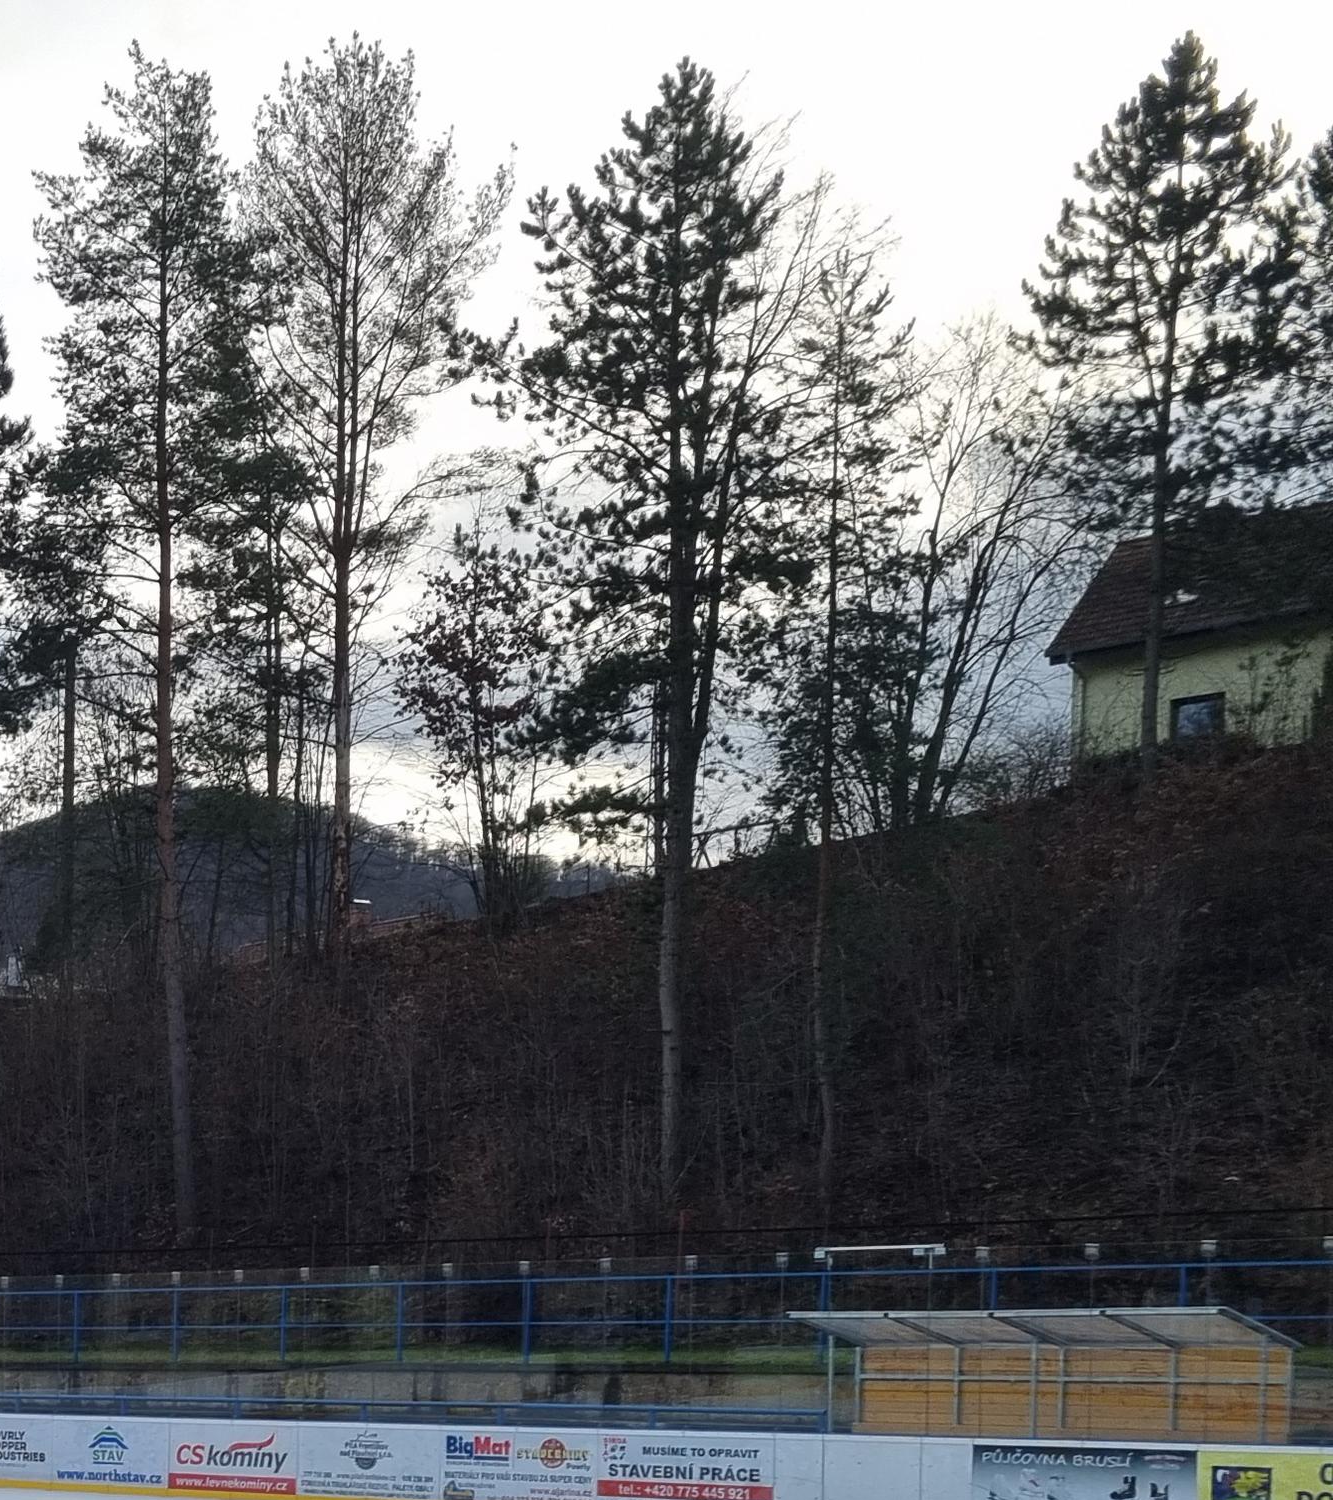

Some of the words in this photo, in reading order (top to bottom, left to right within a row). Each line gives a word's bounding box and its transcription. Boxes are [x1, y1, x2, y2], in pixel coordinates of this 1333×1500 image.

[446, 1435, 511, 1458] BigMat
[642, 1445, 687, 1457] MUSÍME
[691, 1449, 705, 1457] TO
[708, 1449, 759, 1459] OPRAVIT
[93, 1450, 124, 1461] STAV
[982, 1448, 1067, 1465] PŮJČOVNA
[1072, 1452, 1134, 1468] BRUSLÍ
[57, 1469, 163, 1484] www.northstav.cz
[608, 1463, 693, 1480] STAVEBNÍ
[699, 1465, 761, 1482] PRÁCE
[175, 1477, 288, 1493] www.levnekominy.cz
[618, 1484, 641, 1495] tel.:
[644, 1485, 674, 1497] +420
[677, 1486, 699, 1497] 775
[702, 1487, 724, 1499] 445
[729, 1488, 750, 1500] 921
